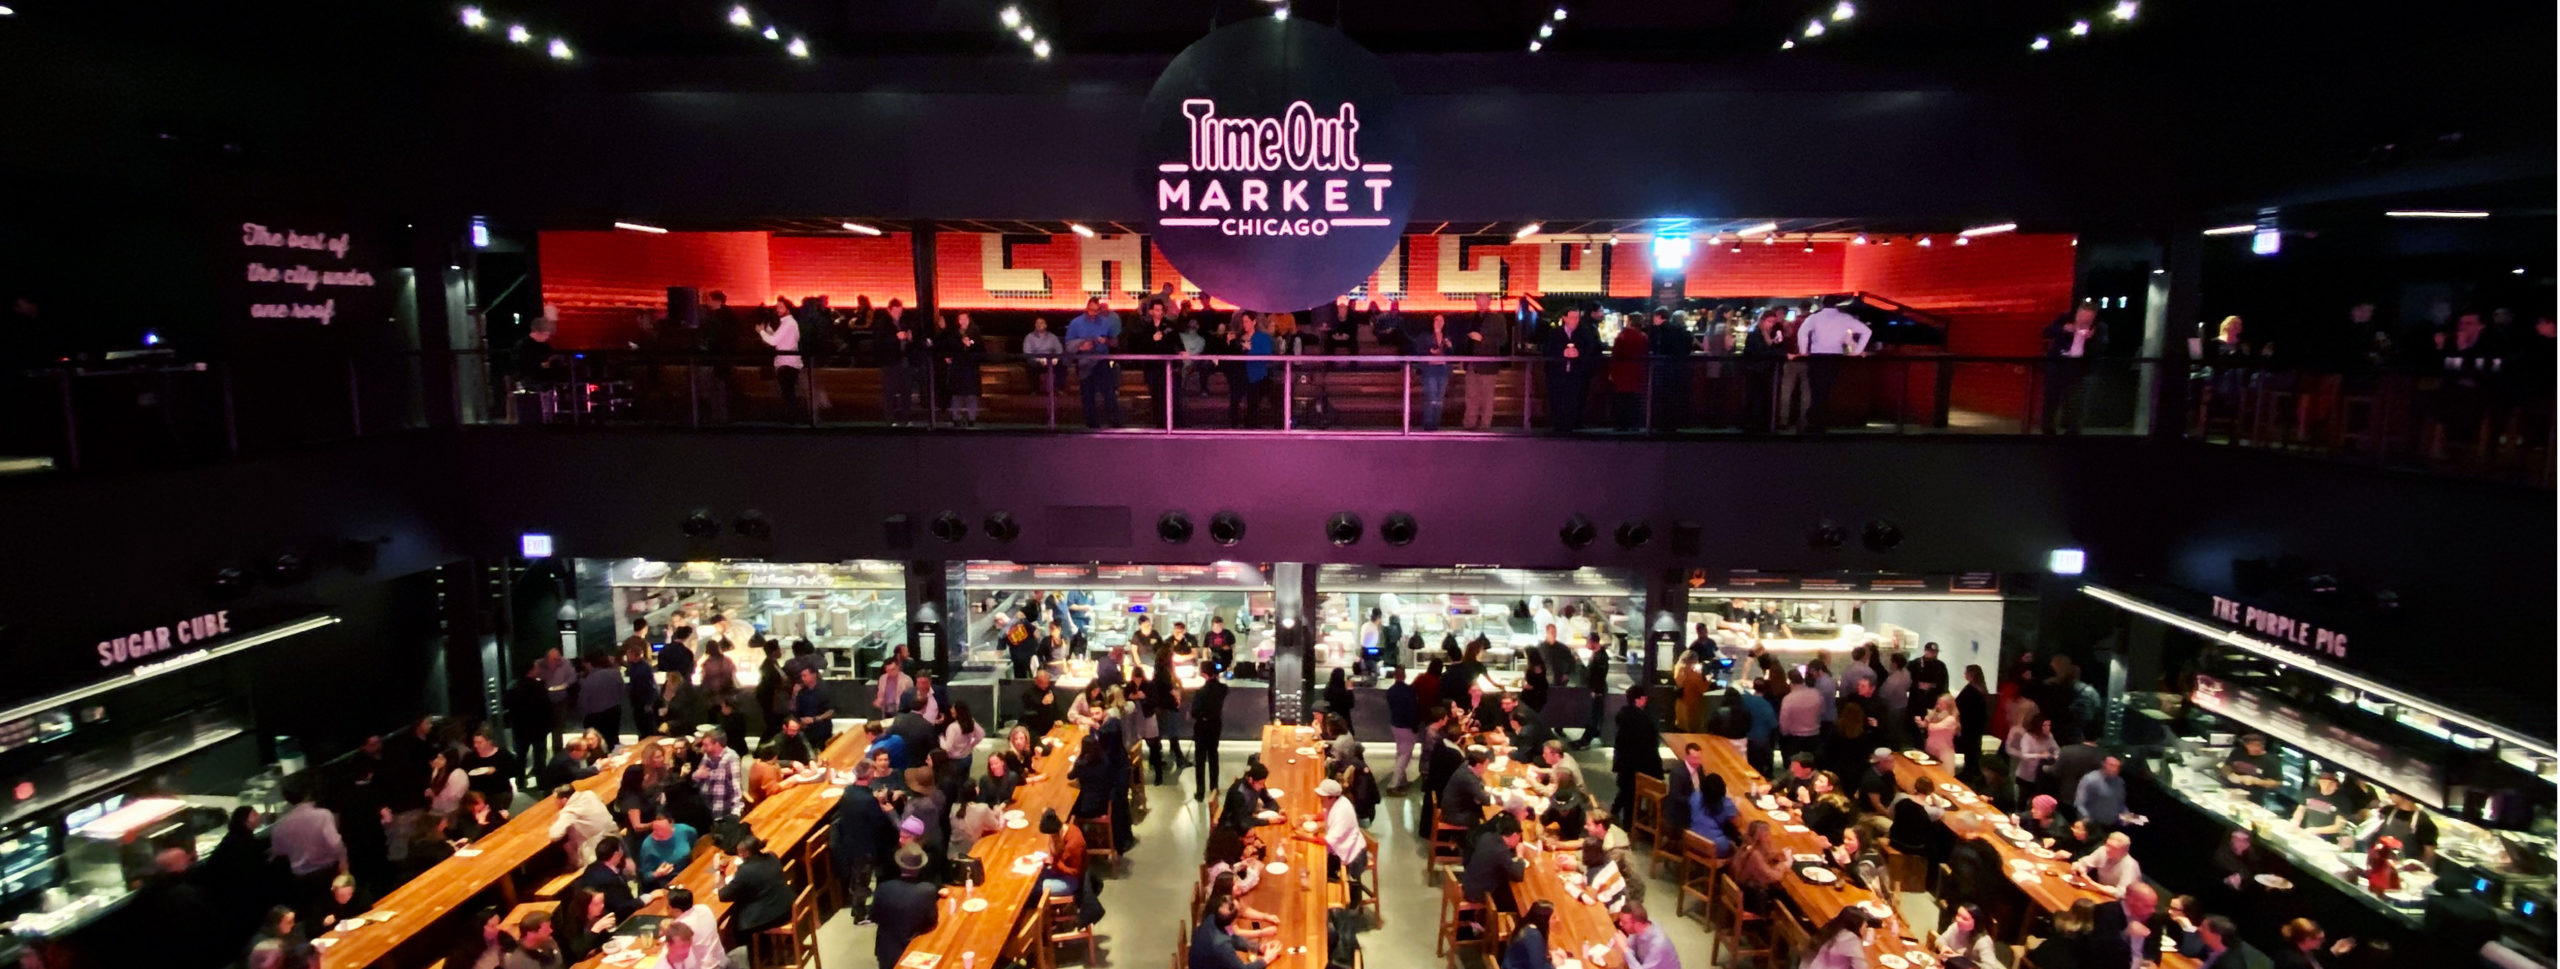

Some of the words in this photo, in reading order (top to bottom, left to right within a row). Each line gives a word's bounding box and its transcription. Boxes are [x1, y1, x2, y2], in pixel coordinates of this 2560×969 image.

[1182, 99, 1283, 171] Time
[1284, 100, 1360, 171] Out
[1158, 178, 1393, 212] MARKET
[242, 222, 284, 247] The
[287, 229, 327, 250] best
[328, 232, 350, 259] of
[1221, 218, 1329, 237] CHICAGO
[247, 262, 279, 282] the
[283, 264, 319, 291] city
[322, 268, 375, 286] under
[250, 303, 288, 318] one
[290, 298, 335, 325] roof
[97, 626, 172, 667] SUGAR
[177, 609, 232, 645] CUBE
[2212, 595, 2241, 624] THE
[2245, 605, 2311, 646] PURPLE
[2315, 627, 2348, 658] PIG
